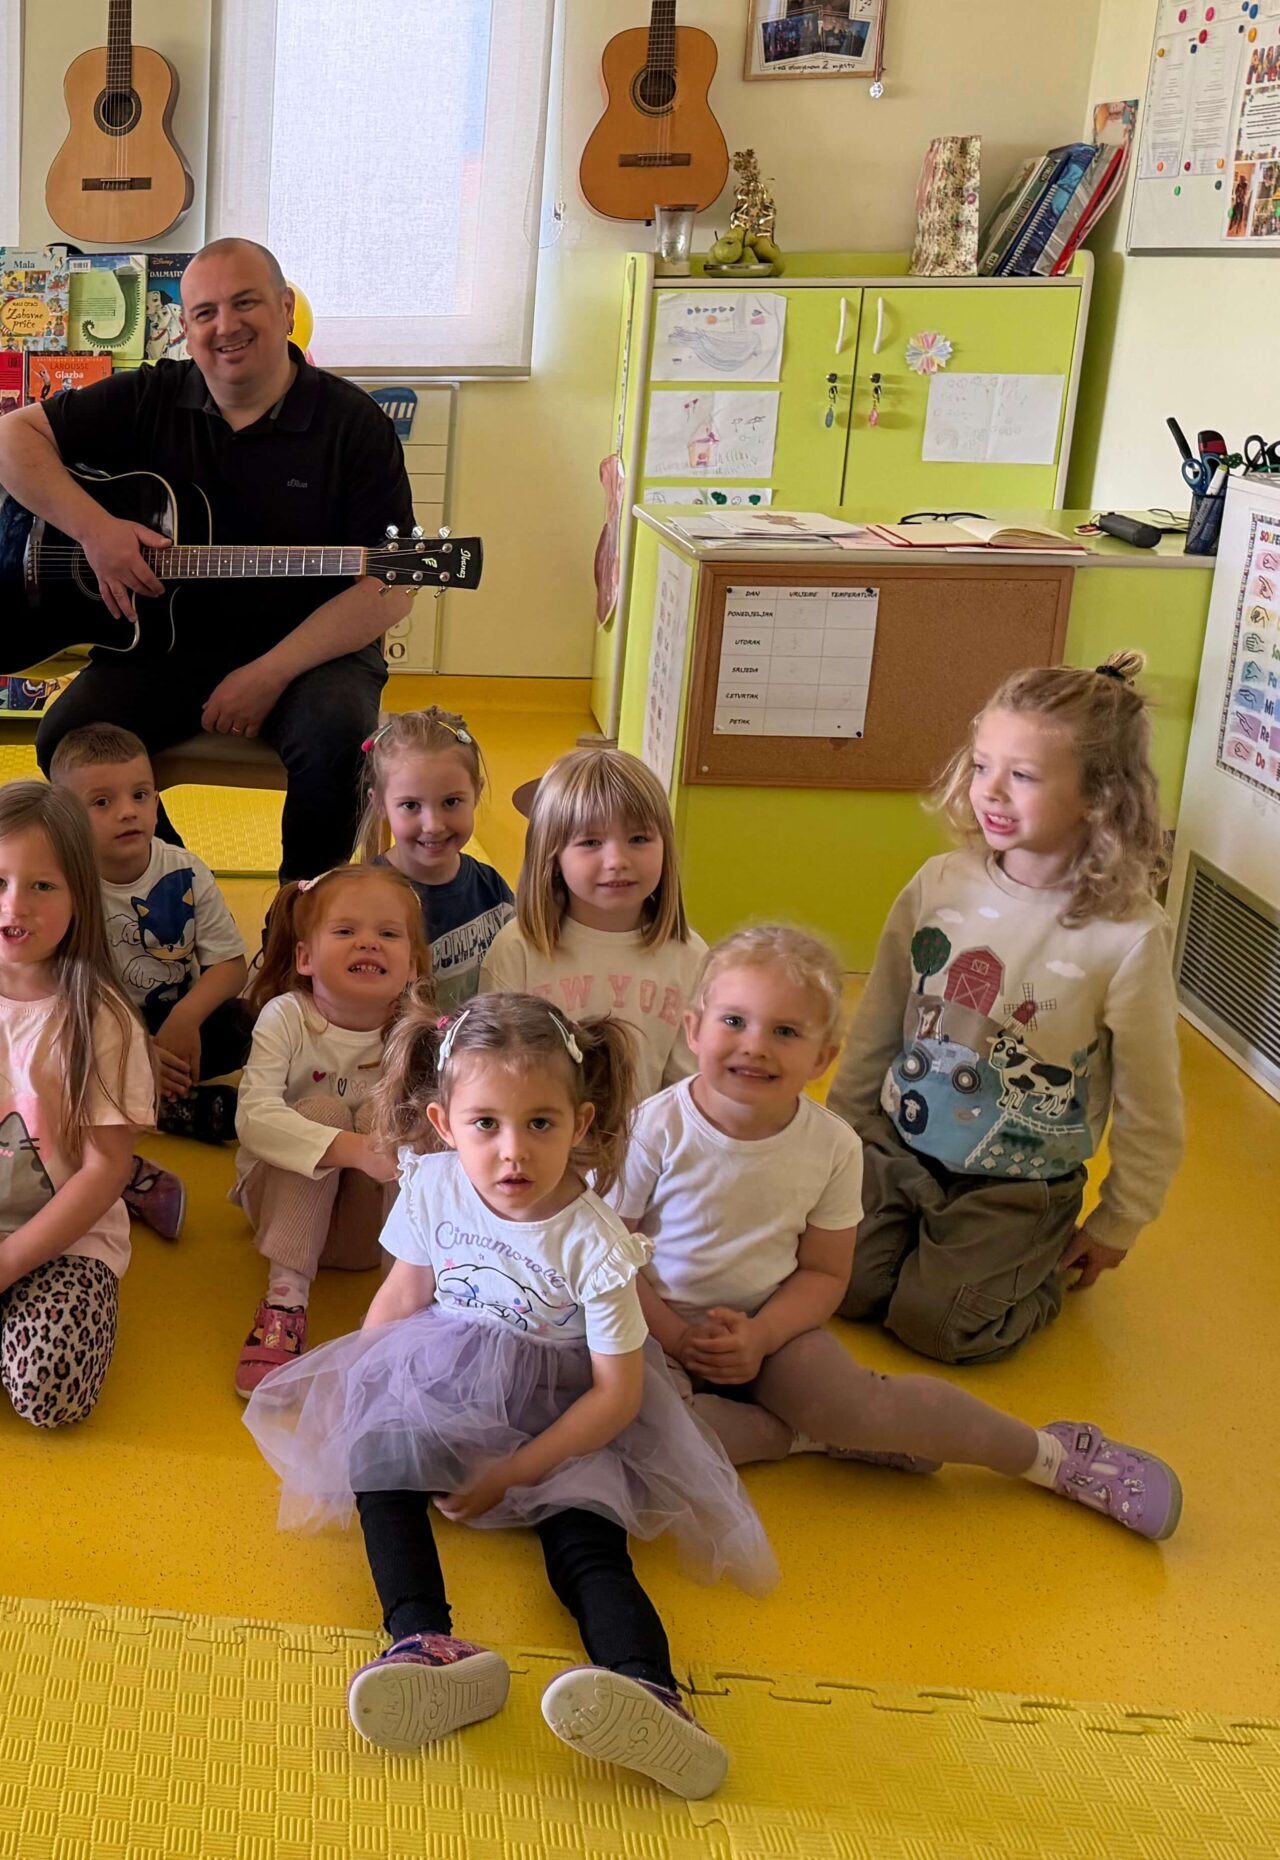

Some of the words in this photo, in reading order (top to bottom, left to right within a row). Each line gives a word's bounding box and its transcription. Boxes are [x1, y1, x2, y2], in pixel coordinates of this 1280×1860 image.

[822, 61, 829, 70] 2
[13, 260, 36, 269] Mala
[7, 308, 44, 320] Zabavne
[12, 320, 36, 331] priče
[55, 370, 84, 379] Glazba
[456, 547, 472, 579] Ibanez
[727, 610, 774, 618] PONEDJELJAK
[734, 638, 761, 646] UTORAK
[1260, 724, 1270, 742] Re
[1255, 752, 1266, 770] Do
[607, 973, 682, 1026] YOR
